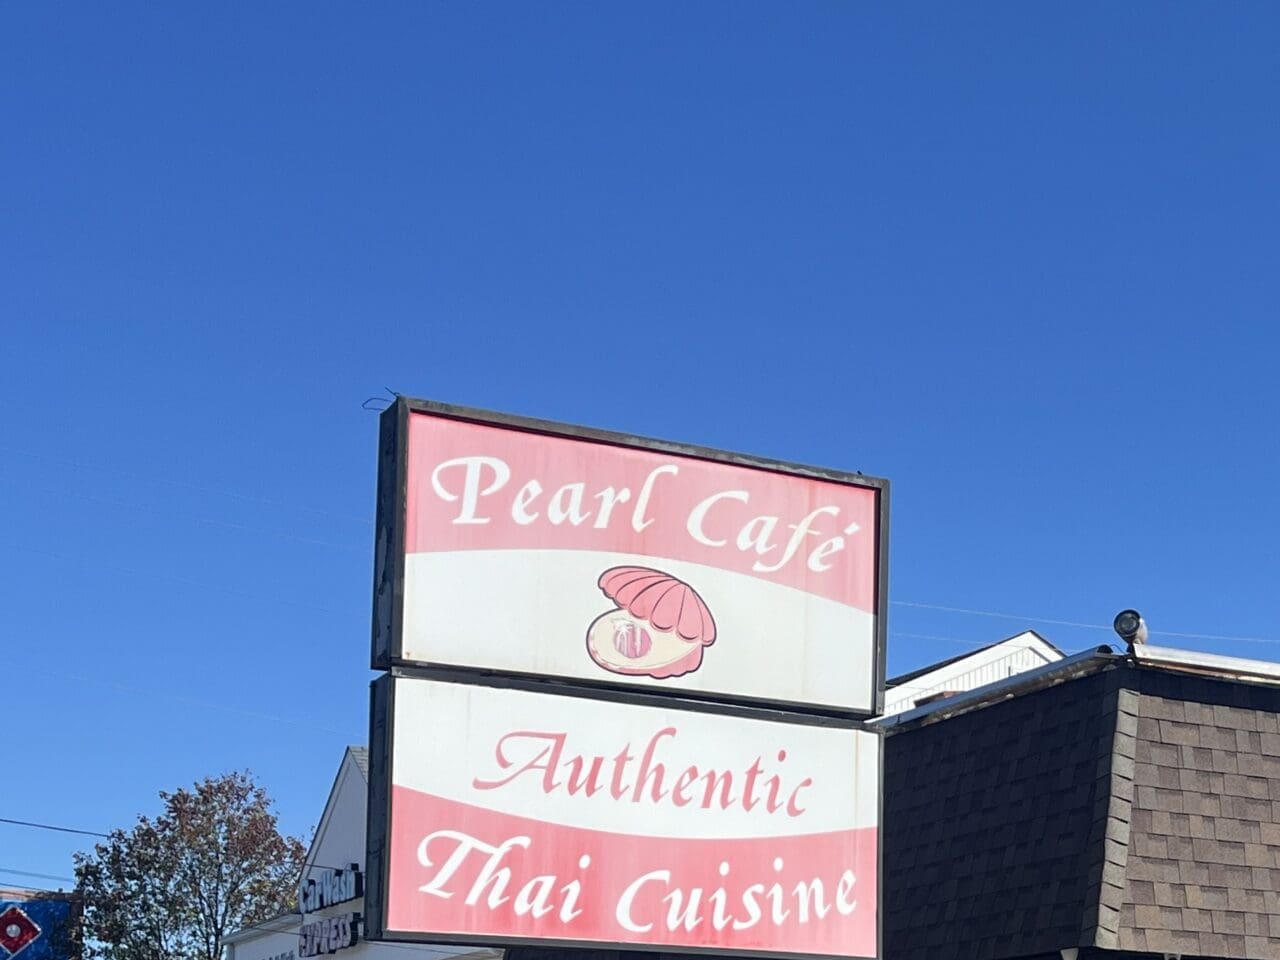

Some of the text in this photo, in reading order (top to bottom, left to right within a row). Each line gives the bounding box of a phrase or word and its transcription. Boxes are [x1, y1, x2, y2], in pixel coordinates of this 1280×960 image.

[431, 455, 863, 574] Pearl Café
[472, 726, 812, 818] Authentic
[417, 829, 858, 934] Thai Cuisine
